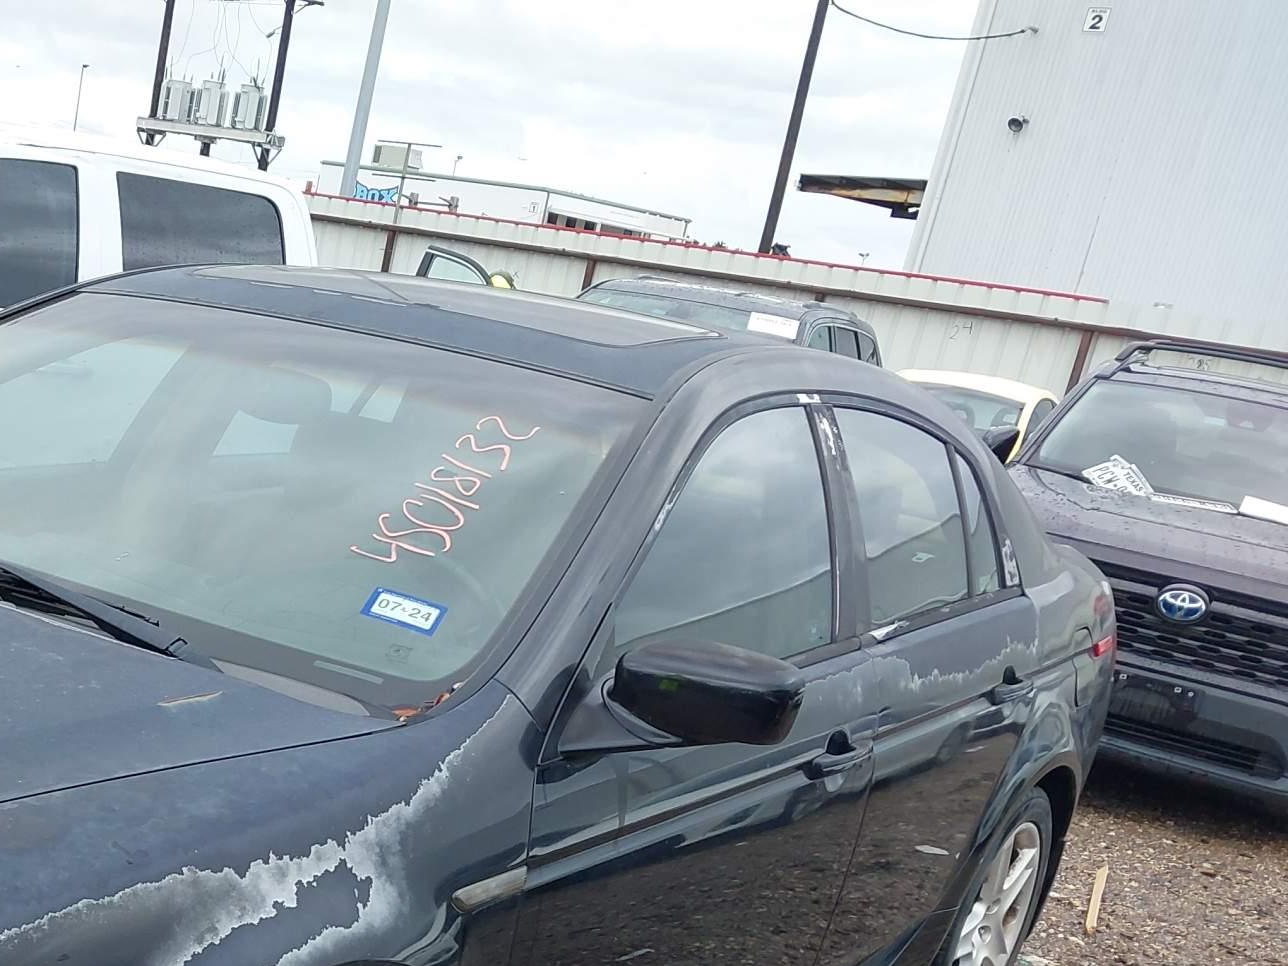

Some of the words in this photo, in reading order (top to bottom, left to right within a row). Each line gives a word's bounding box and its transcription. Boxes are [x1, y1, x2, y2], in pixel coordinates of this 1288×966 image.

[1088, 14, 1103, 30] 2
[349, 415, 541, 563] 45018132
[1123, 471, 1145, 492] TEXAS
